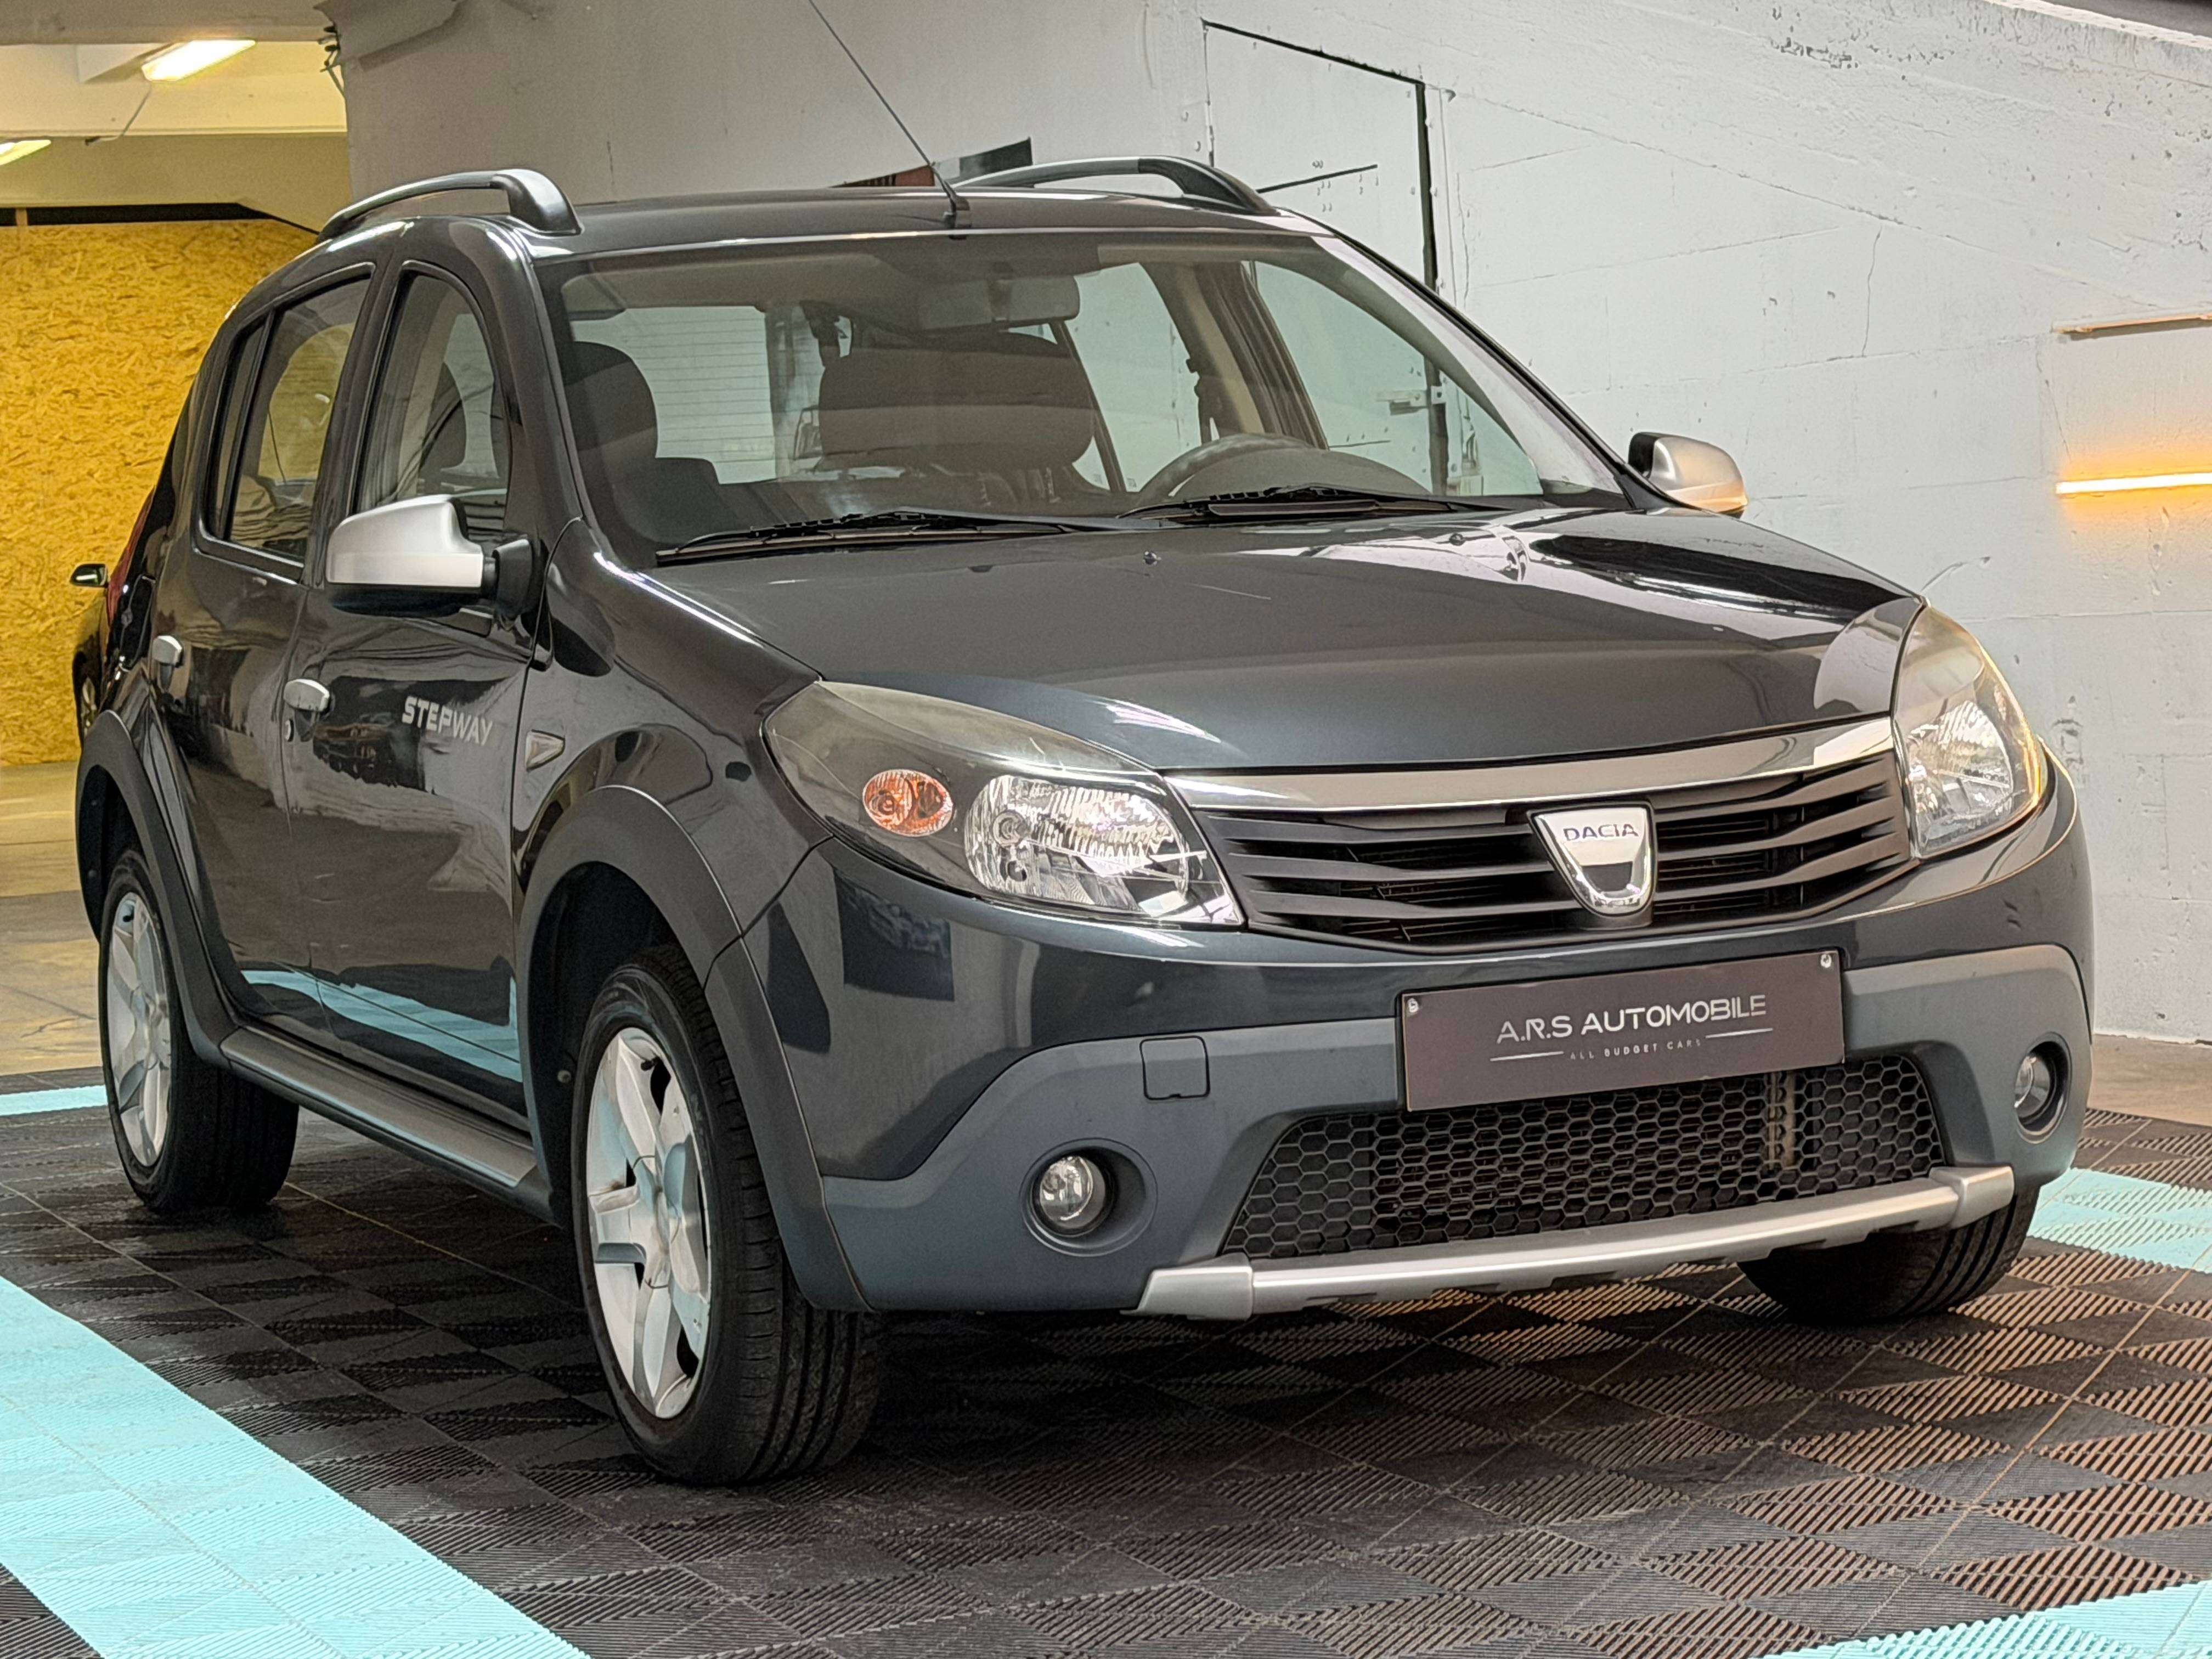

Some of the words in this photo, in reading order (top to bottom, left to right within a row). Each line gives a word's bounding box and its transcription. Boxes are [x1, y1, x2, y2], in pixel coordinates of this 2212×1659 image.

[402, 696, 493, 746] STEPWAY
[1564, 823, 1639, 841] DACIA
[1497, 1015, 1572, 1044] A.R.S
[1581, 994, 1767, 1035] AUTOMOBILE
[1571, 1051, 1594, 1060] ALL
[1604, 1043, 1657, 1057] BUDGET
